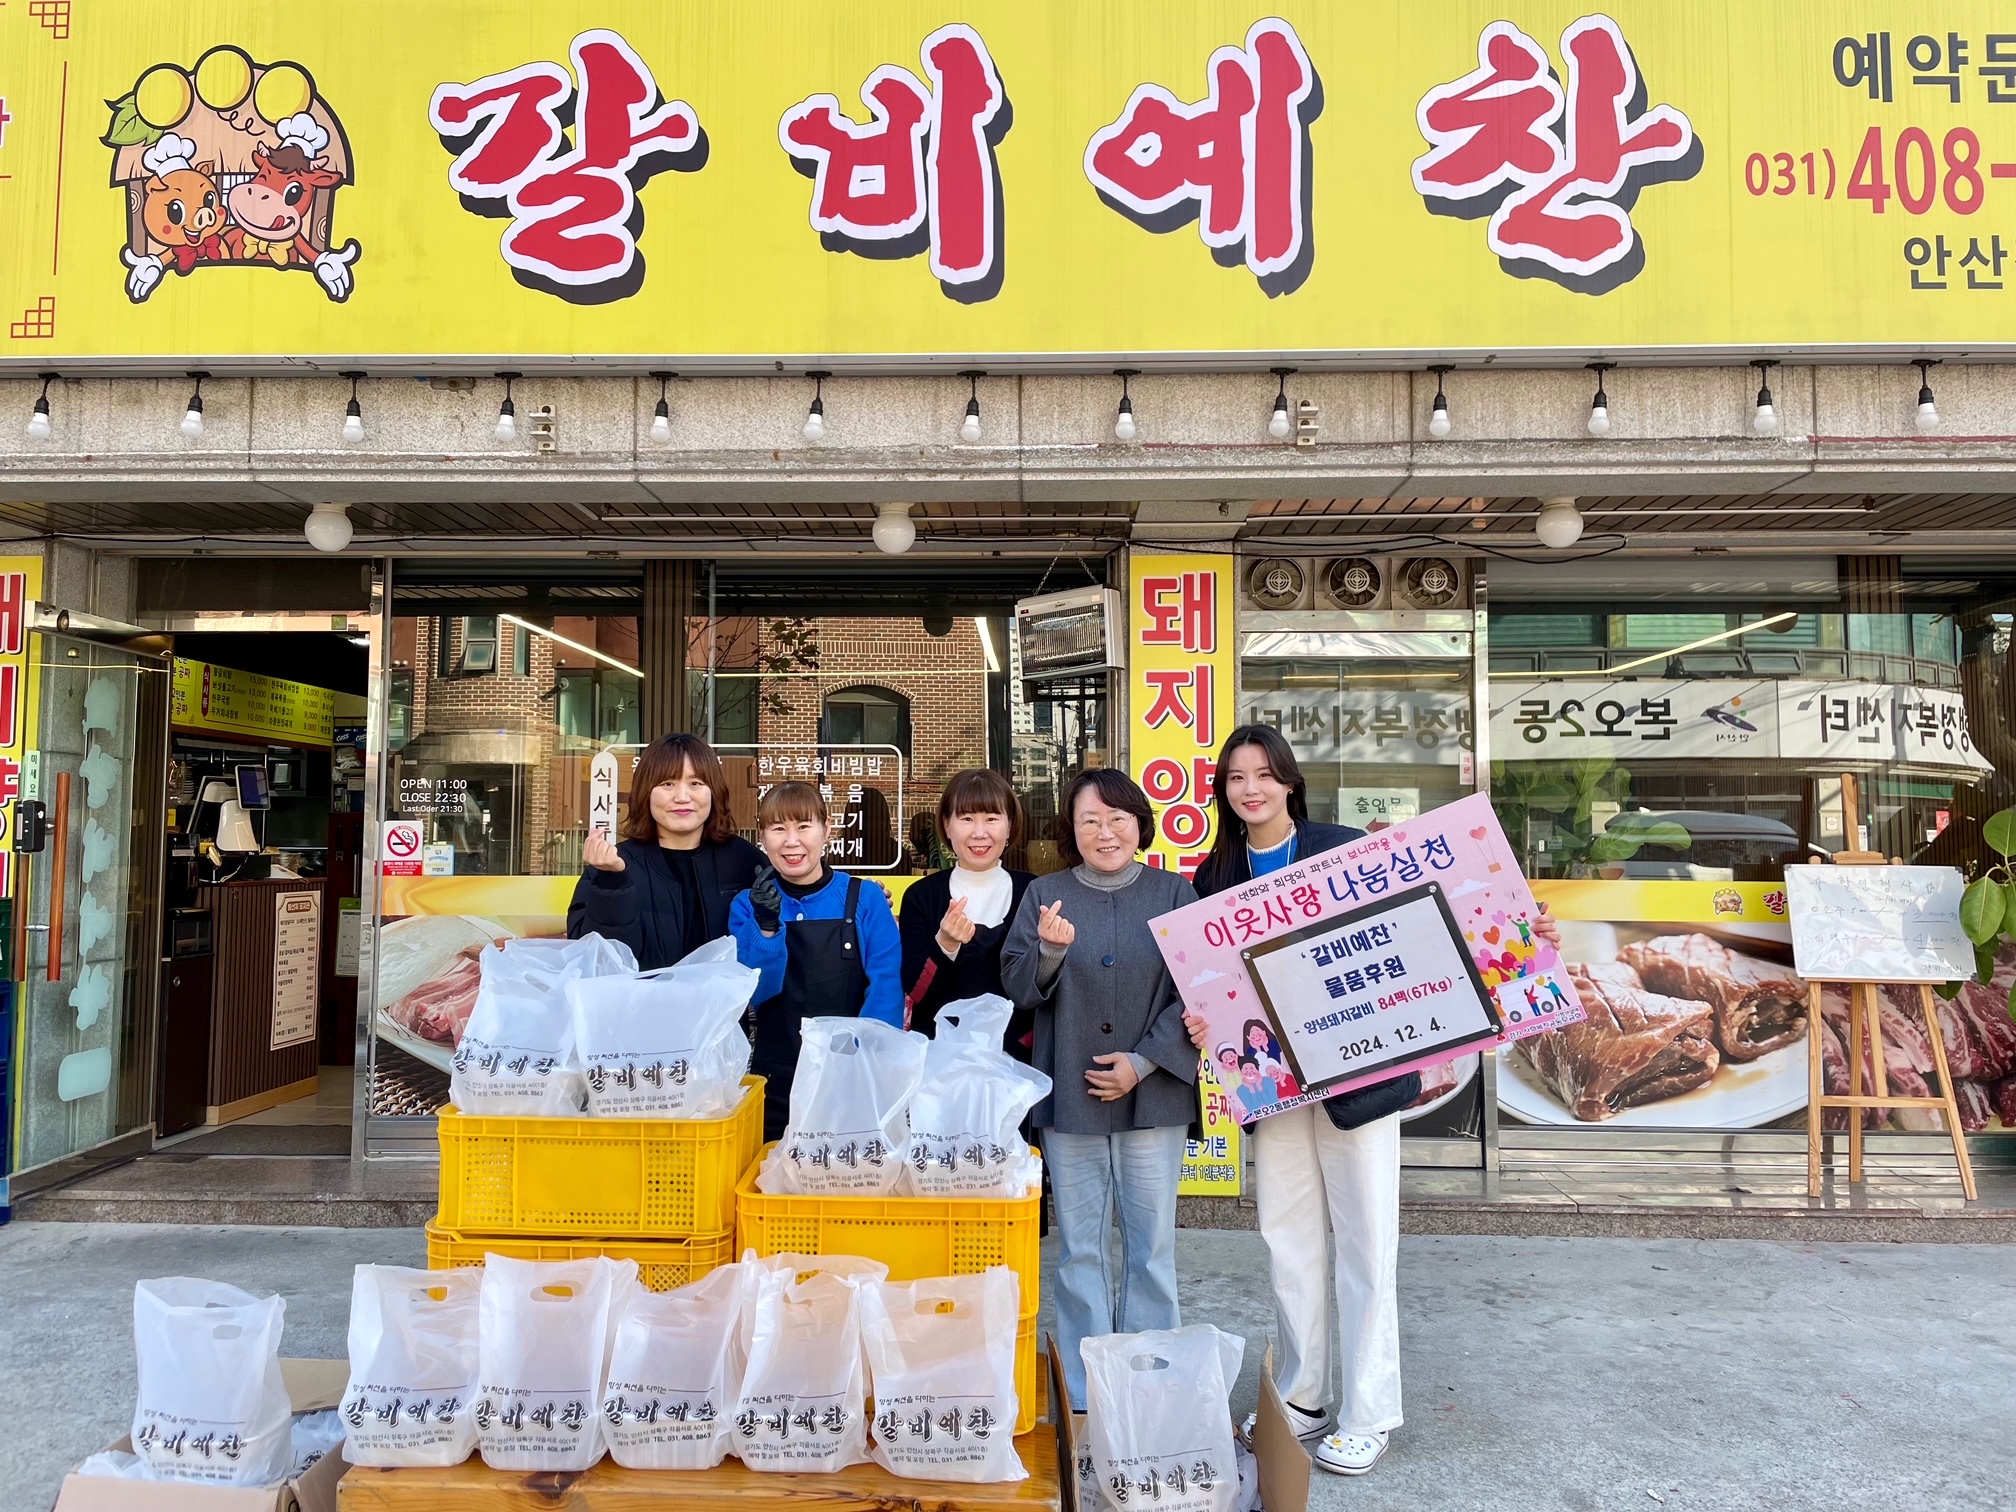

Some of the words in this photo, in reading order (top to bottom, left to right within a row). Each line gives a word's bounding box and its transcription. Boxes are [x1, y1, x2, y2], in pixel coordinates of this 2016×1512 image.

[430, 16, 1704, 305] 갈비예찬
[1903, 234, 2016, 290] 안산
[248, 687, 267, 699] 13,000
[249, 674, 268, 687] 15,000
[302, 686, 320, 698] 13,000
[246, 711, 265, 723] 10,000
[247, 699, 266, 711] 10,000
[301, 697, 319, 709] 10,000
[303, 710, 318, 721] 9,000
[302, 722, 317, 732] 9,000
[1140, 571, 1217, 884] 돼지양
[758, 756, 883, 776] 한우육회비빔밥
[400, 779, 432, 789] OPEN
[436, 779, 468, 790] 11:00
[400, 792, 431, 803] CLOSE
[434, 792, 467, 803] 22:30
[420, 804, 439, 813] Oder
[440, 805, 463, 813] 21:30
[1355, 796, 1403, 814] 출입문
[1238, 883, 1270, 902] 변화와
[1273, 870, 1306, 889] 희망의
[1309, 854, 1343, 874] 파트너
[1347, 837, 1391, 860] 보니마을
[1203, 883, 1323, 949] 이웃사랑
[1327, 833, 1456, 902] 나눔실천
[1323, 954, 1407, 1000] 물품후원
[1303, 1001, 1376, 1035] 양념돼지갈비
[1377, 976, 1454, 1011] 84팩(67kg)
[1339, 1035, 1389, 1061] 2024.
[1394, 1024, 1423, 1043] 12.
[1429, 1016, 1447, 1032] 4.
[587, 1057, 689, 1094] 갈비예찬
[911, 1142, 1012, 1173] 갈비예찬
[1202, 1135, 1227, 1157] 기본
[1178, 1163, 1197, 1182] 부터
[345, 1395, 462, 1428] 갈비예찬
[476, 1398, 589, 1432] 갈비예찬
[603, 1394, 718, 1426] 갈비예찬
[734, 1403, 849, 1440] 갈비예찬
[877, 1405, 997, 1443] 갈비예찬
[1110, 1459, 1218, 1503] 갈비예찬
